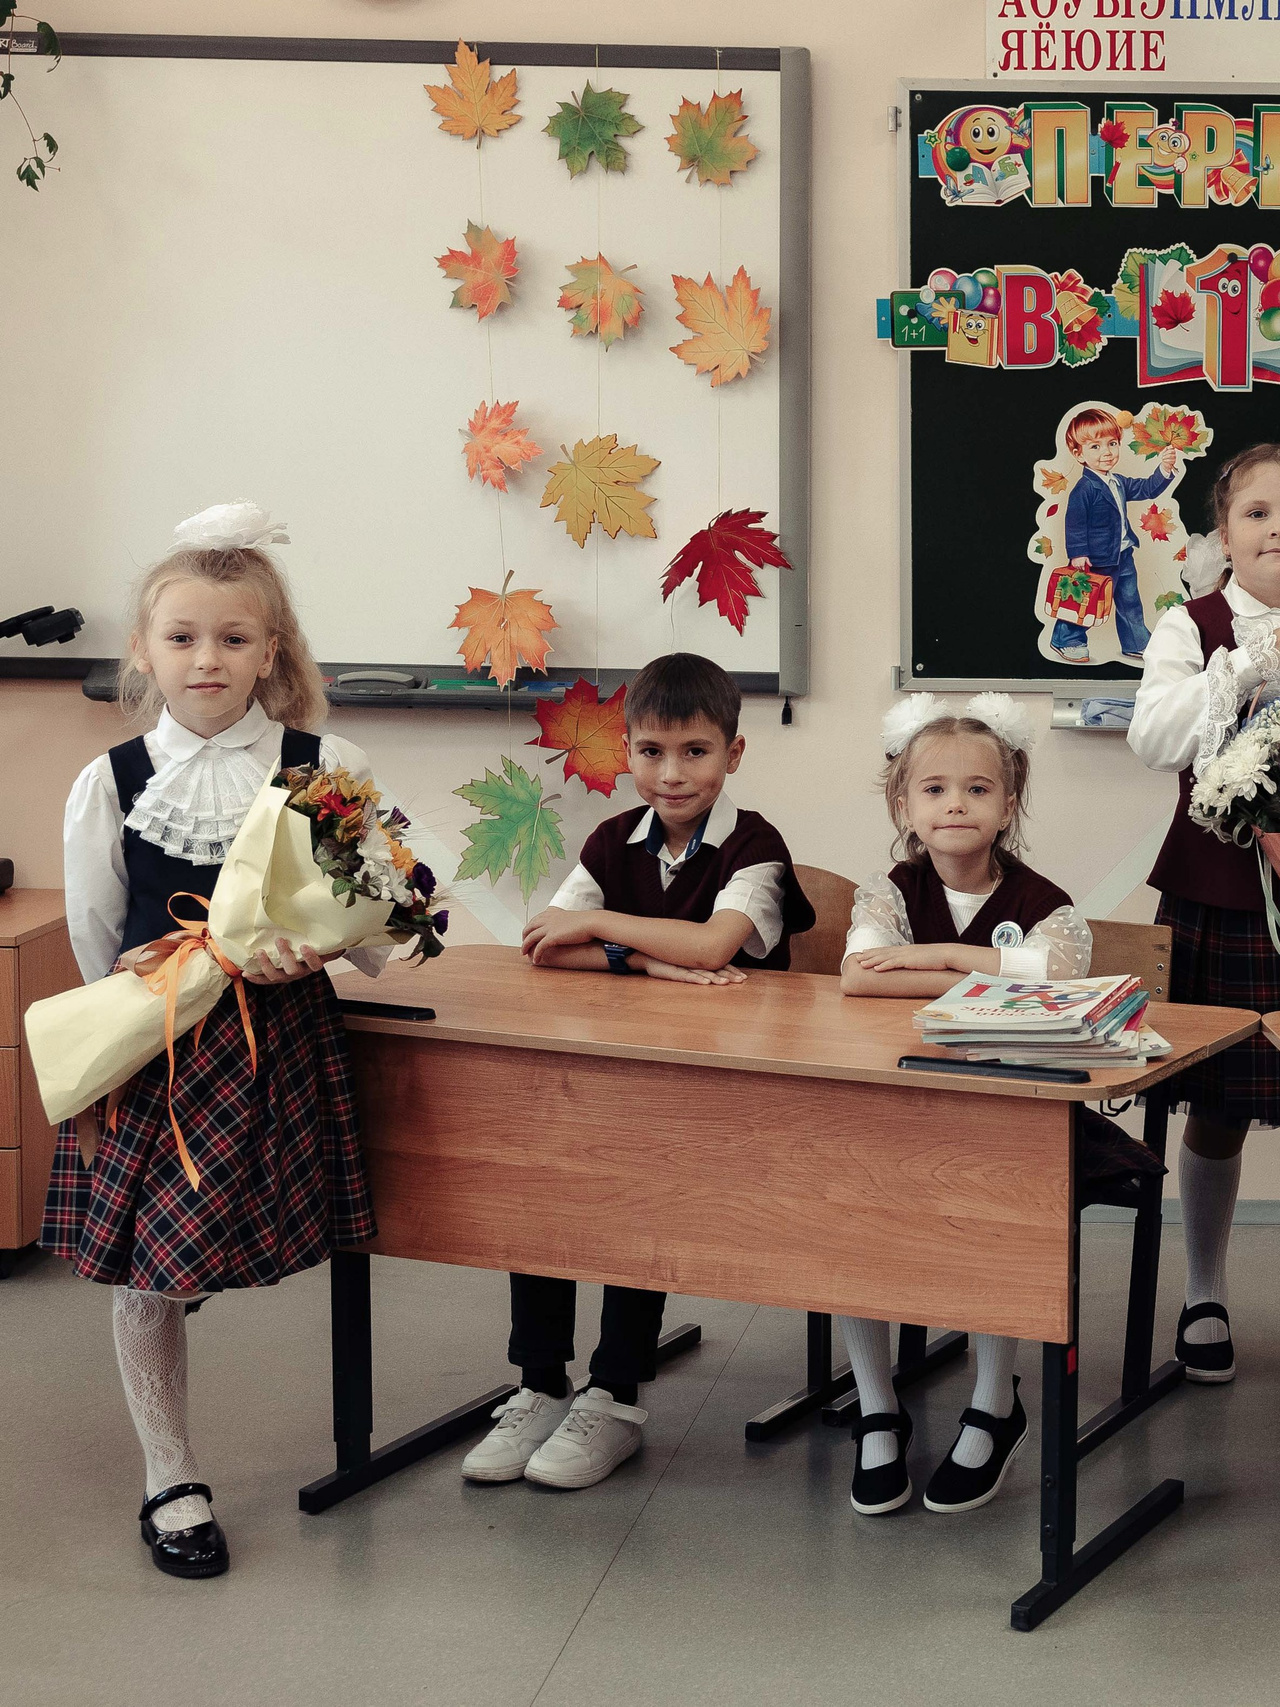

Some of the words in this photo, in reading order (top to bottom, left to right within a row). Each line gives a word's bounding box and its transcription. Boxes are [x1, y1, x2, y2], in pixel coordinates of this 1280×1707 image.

[998, 22, 1166, 72] ЯЁЮИЕ
[900, 324, 927, 342] 1+1
[994, 265, 1059, 370] В
[1185, 244, 1253, 392] 1
